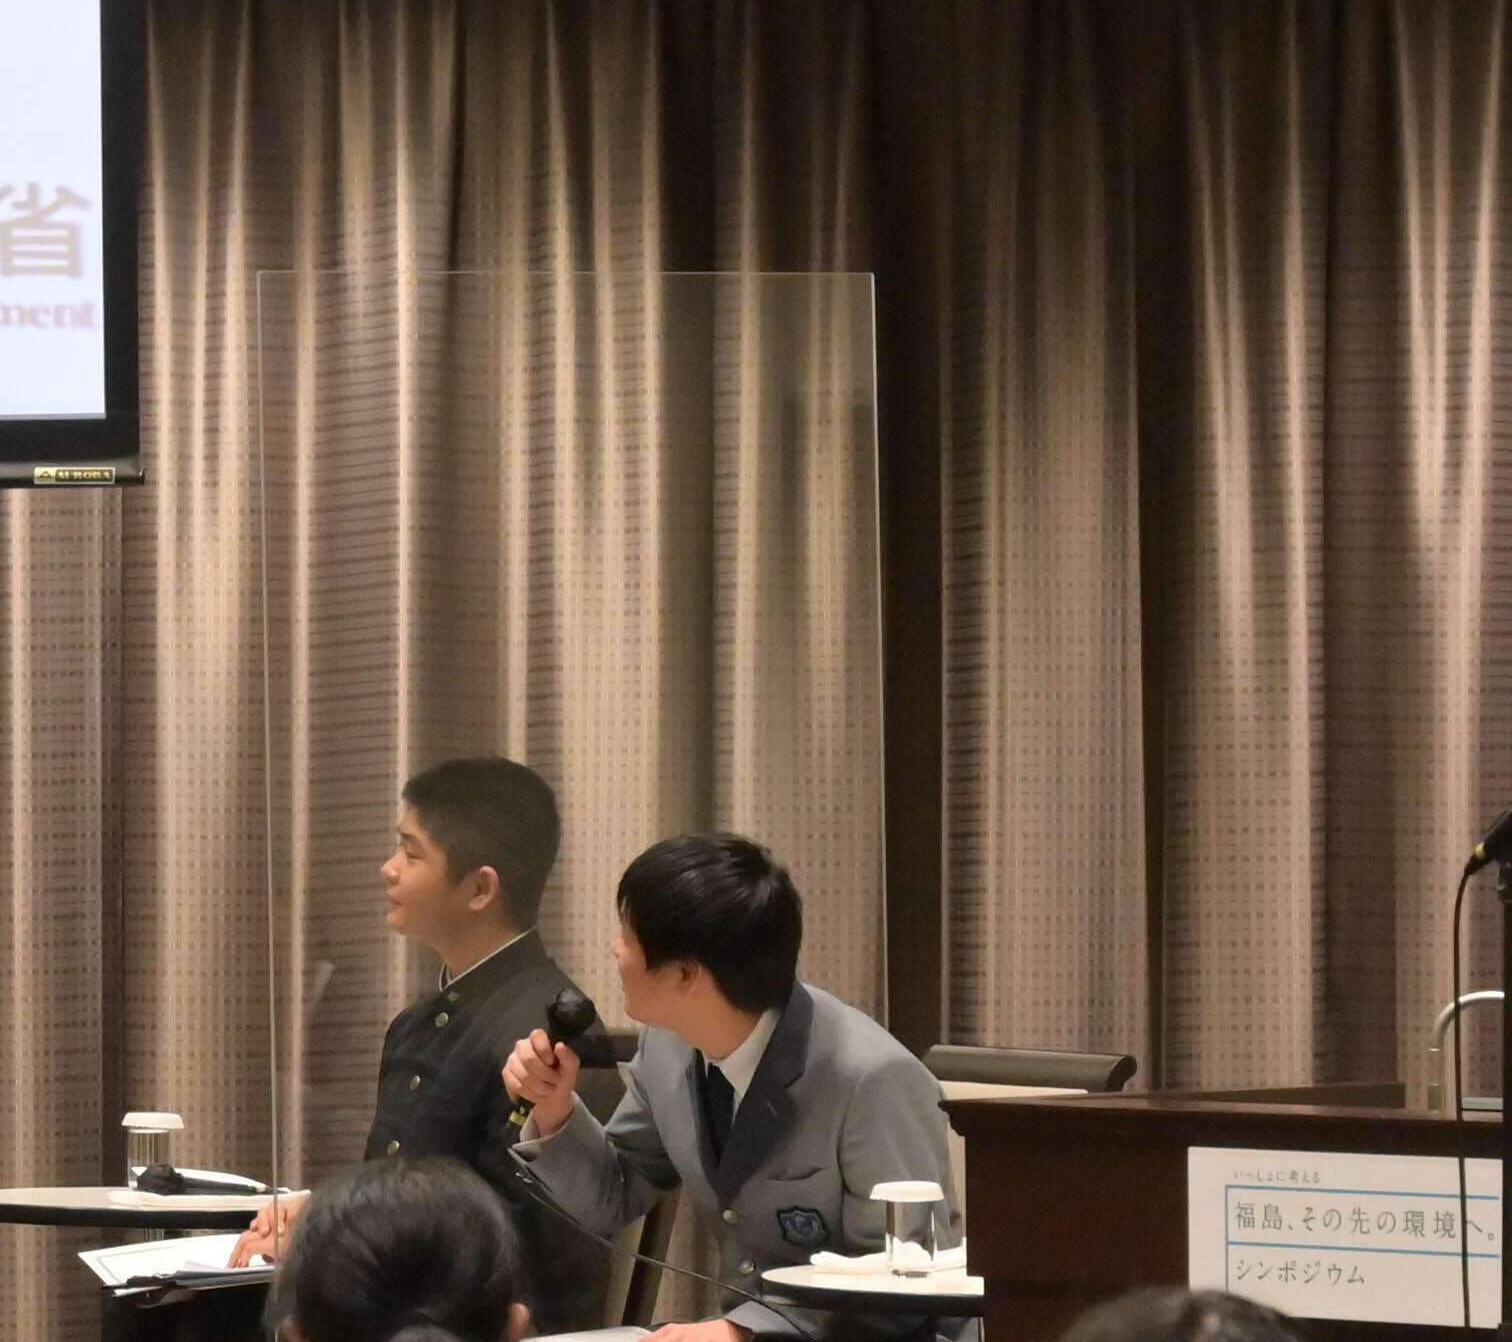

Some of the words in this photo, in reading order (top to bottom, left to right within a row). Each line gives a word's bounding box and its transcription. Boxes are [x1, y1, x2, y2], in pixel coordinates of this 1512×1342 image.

[1233, 1169, 1321, 1184] いっしょに考える
[1235, 1200, 1495, 1242] 福島、その先の環境へ。
[1235, 1258, 1366, 1286] シンポジウム
